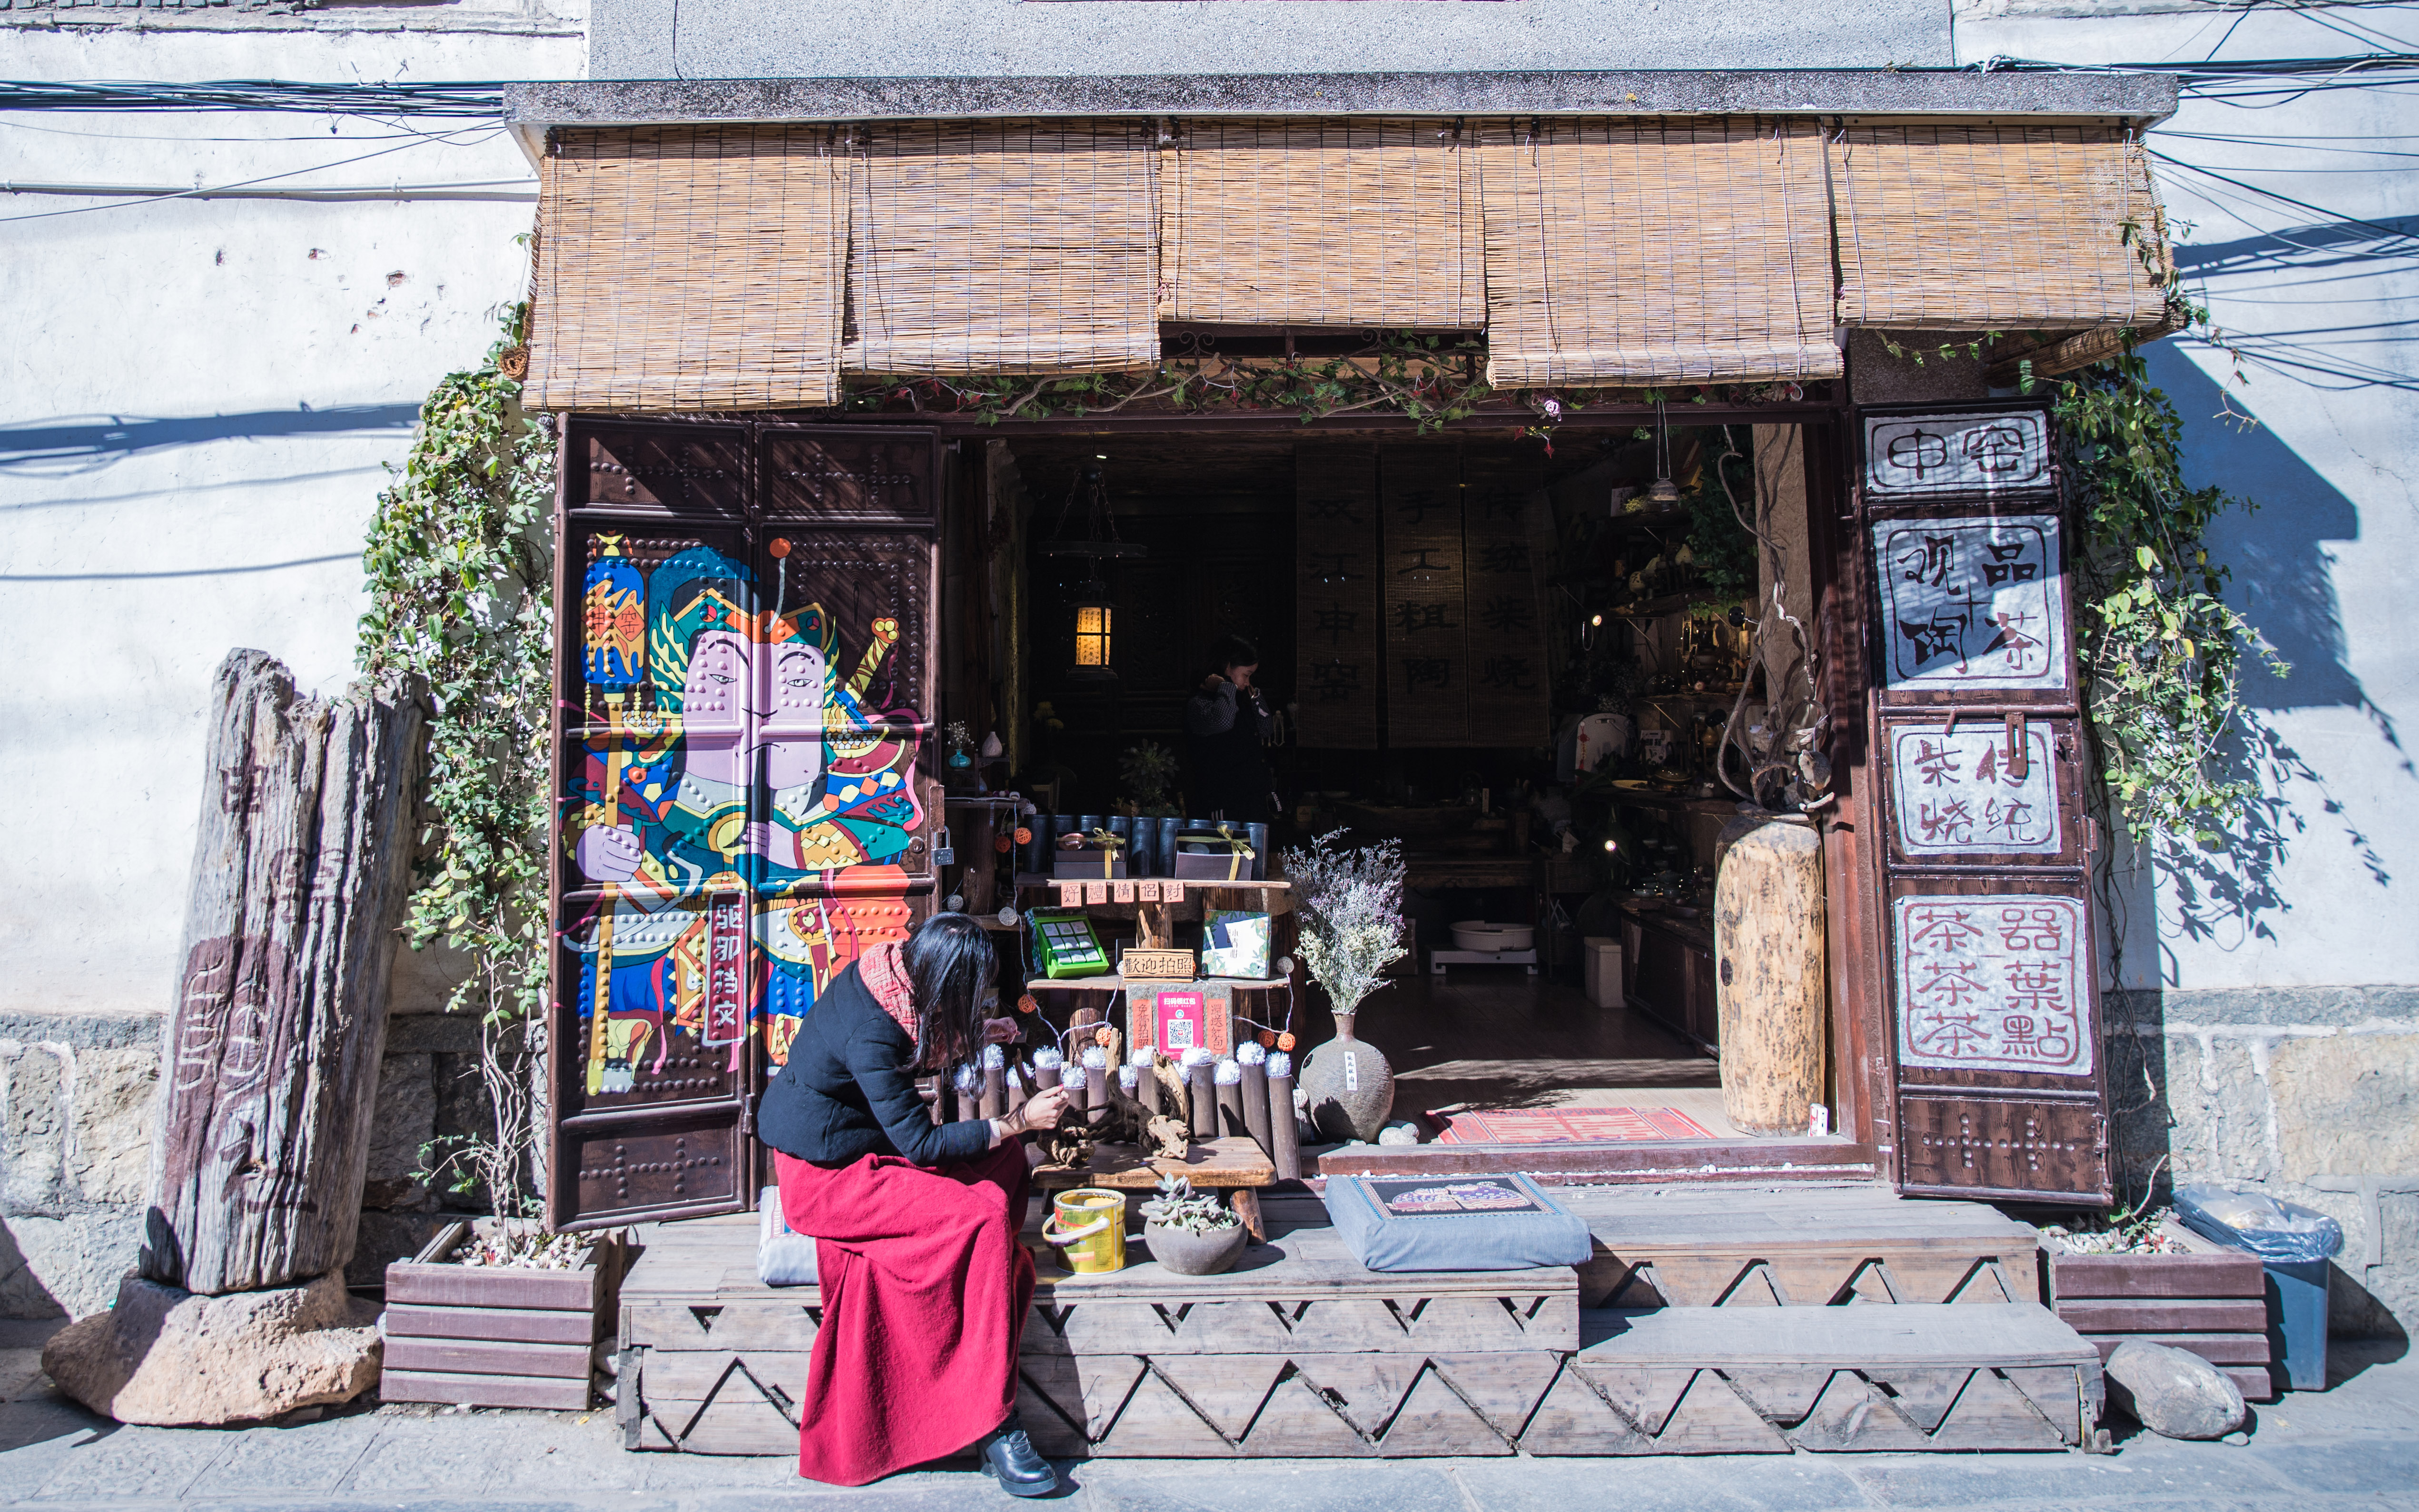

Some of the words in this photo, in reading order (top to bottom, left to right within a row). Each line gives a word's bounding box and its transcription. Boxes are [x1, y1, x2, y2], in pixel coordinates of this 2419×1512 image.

[1125, 957, 1192, 974] 歡迎拍照
[1544, 1108, 1629, 1117] HAPPINESS
